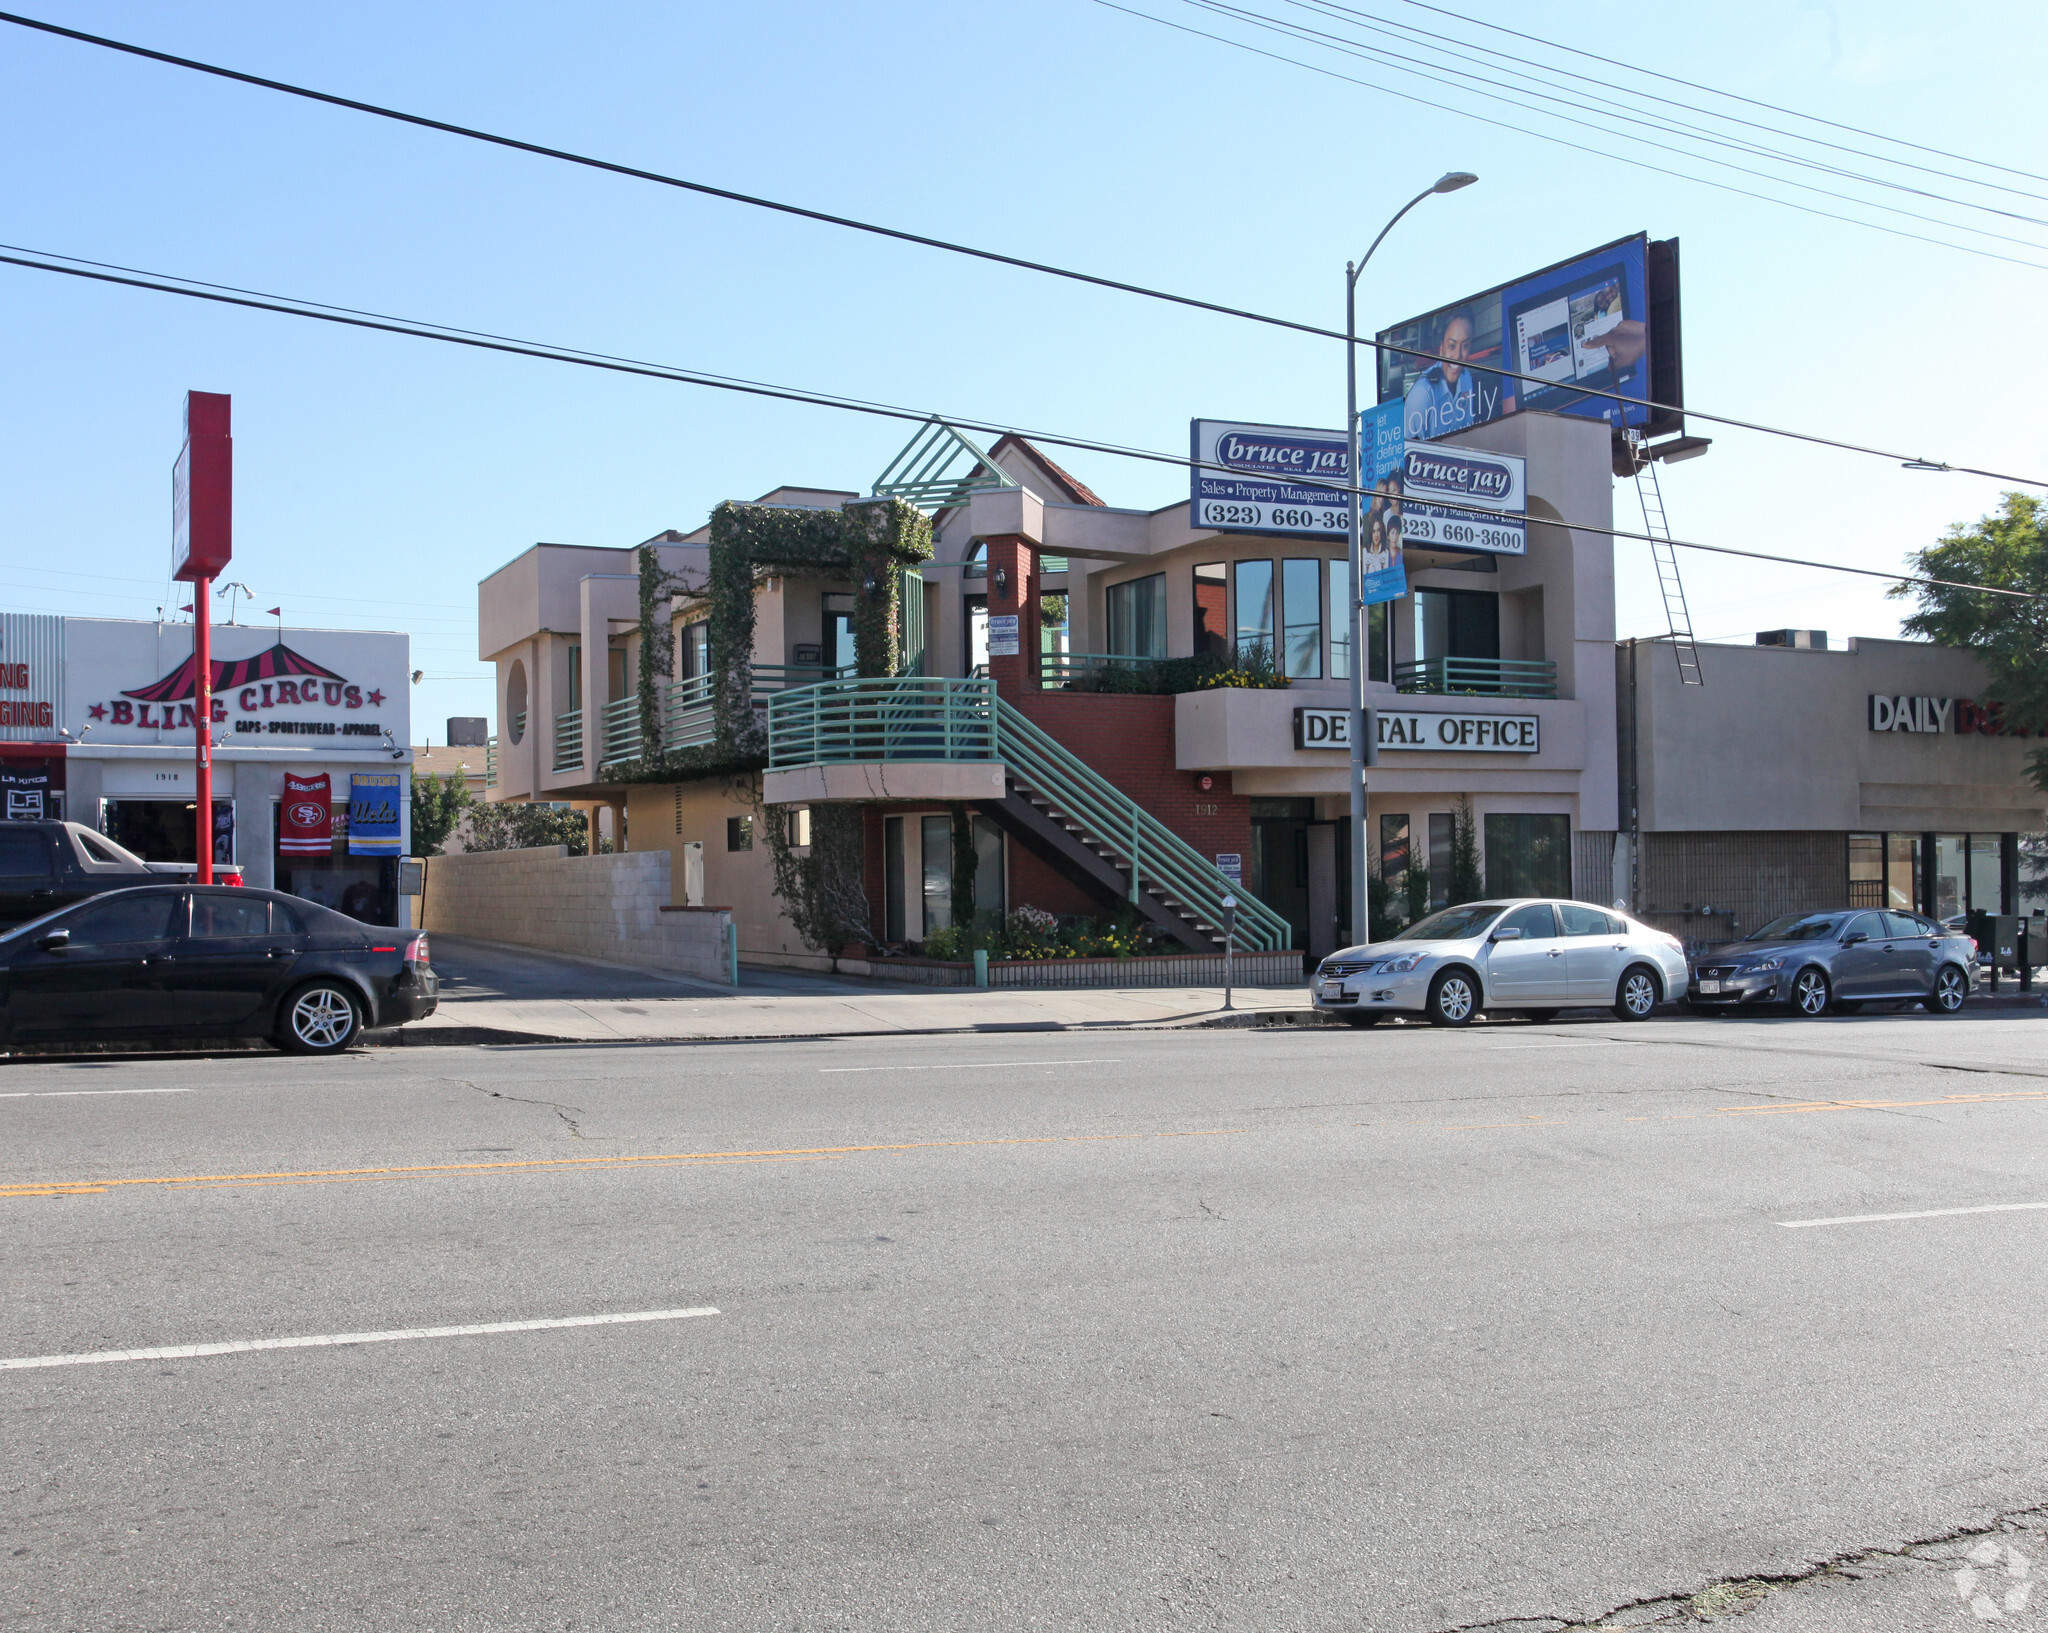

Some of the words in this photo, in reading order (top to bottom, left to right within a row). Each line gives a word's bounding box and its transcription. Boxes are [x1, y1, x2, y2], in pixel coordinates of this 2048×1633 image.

[1408, 381, 1498, 435] onestly
[1376, 414, 1387, 427] let
[1377, 426, 1401, 446] love
[1227, 437, 1305, 465] bruce
[1306, 450, 1349, 476] jay
[1376, 443, 1403, 461] define
[1376, 459, 1402, 475] family
[1408, 454, 1468, 482] bruce
[1469, 470, 1508, 495] jay
[1202, 481, 1226, 495] Sales
[1236, 482, 1277, 501] Property
[1280, 486, 1340, 504] Management
[1205, 502, 1262, 527] (323)
[1271, 508, 1350, 530] 660-36
[1442, 523, 1521, 549] 660-3600
[110, 699, 229, 730] BLING
[239, 678, 364, 712] CIRCUS
[1870, 694, 1953, 734] DAILY
[235, 720, 262, 734] CAPS
[268, 721, 336, 736] SPORTSWEAR
[342, 723, 382, 737] APPAREL
[1306, 715, 1426, 744] DETAL
[1438, 719, 1535, 746] OFFICE
[287, 781, 327, 793] 49ERS
[352, 775, 399, 787] BRUINS
[11, 794, 40, 807] LA
